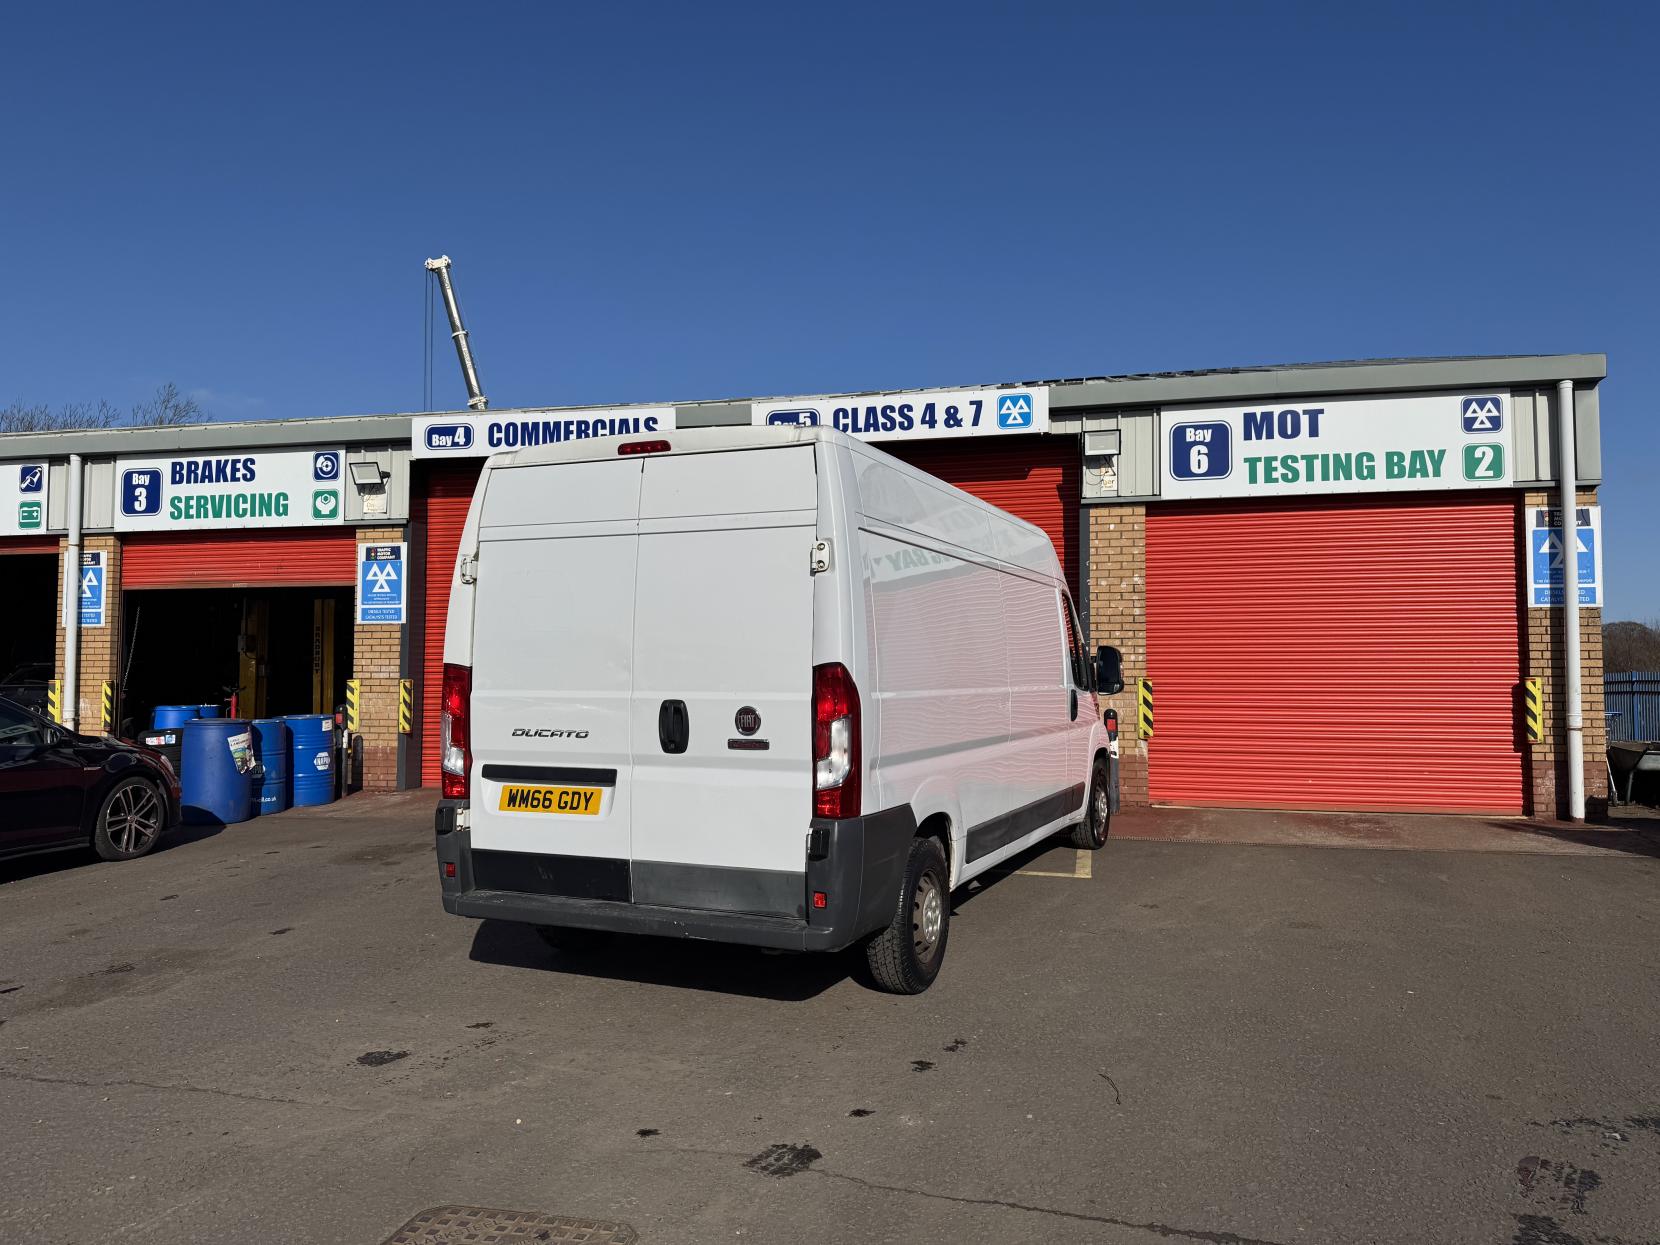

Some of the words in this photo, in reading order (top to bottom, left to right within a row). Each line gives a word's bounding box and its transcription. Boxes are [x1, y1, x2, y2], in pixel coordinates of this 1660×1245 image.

[833, 404, 914, 433] CLASS
[920, 403, 938, 429] 4
[943, 405, 963, 428] &
[968, 400, 984, 427] 7
[1243, 408, 1325, 441] MOT
[432, 435, 451, 447] Bay
[453, 427, 466, 445] 4
[1185, 428, 1212, 443] Bay
[171, 458, 256, 485] BRAKES
[1189, 444, 1209, 474] 6
[1244, 451, 1376, 484] TESTING
[1385, 449, 1446, 480] BAY
[1474, 446, 1494, 477] 2
[132, 473, 150, 486] Bay
[134, 487, 147, 512] 3
[170, 492, 289, 520] SERVICING
[511, 728, 590, 739] DUCATO
[739, 714, 756, 728] FIAT
[507, 788, 553, 809] WM66
[557, 790, 594, 811] GDY
